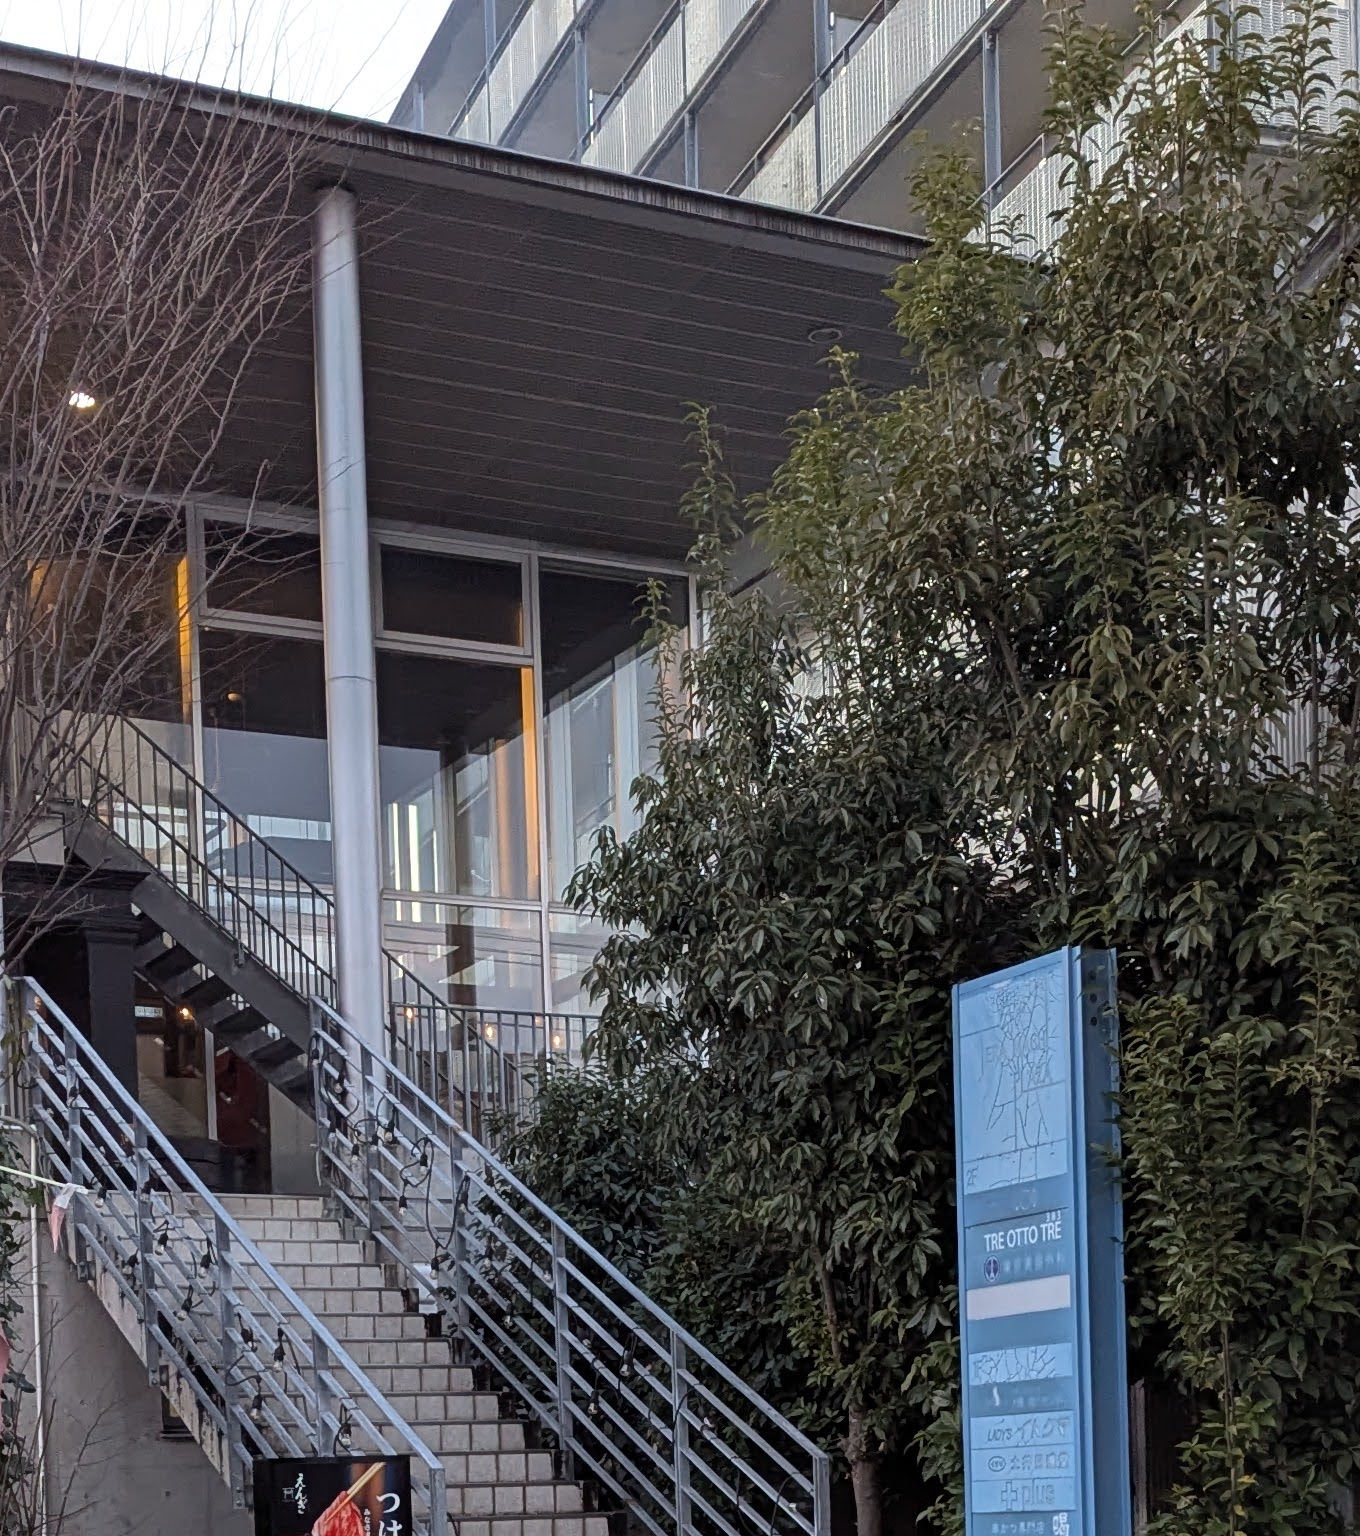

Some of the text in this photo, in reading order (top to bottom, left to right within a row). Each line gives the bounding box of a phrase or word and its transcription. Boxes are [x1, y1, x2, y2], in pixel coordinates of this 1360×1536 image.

[984, 1221, 1062, 1252] TRE OTTO TRE
[295, 1473, 308, 1514] えんぎ
